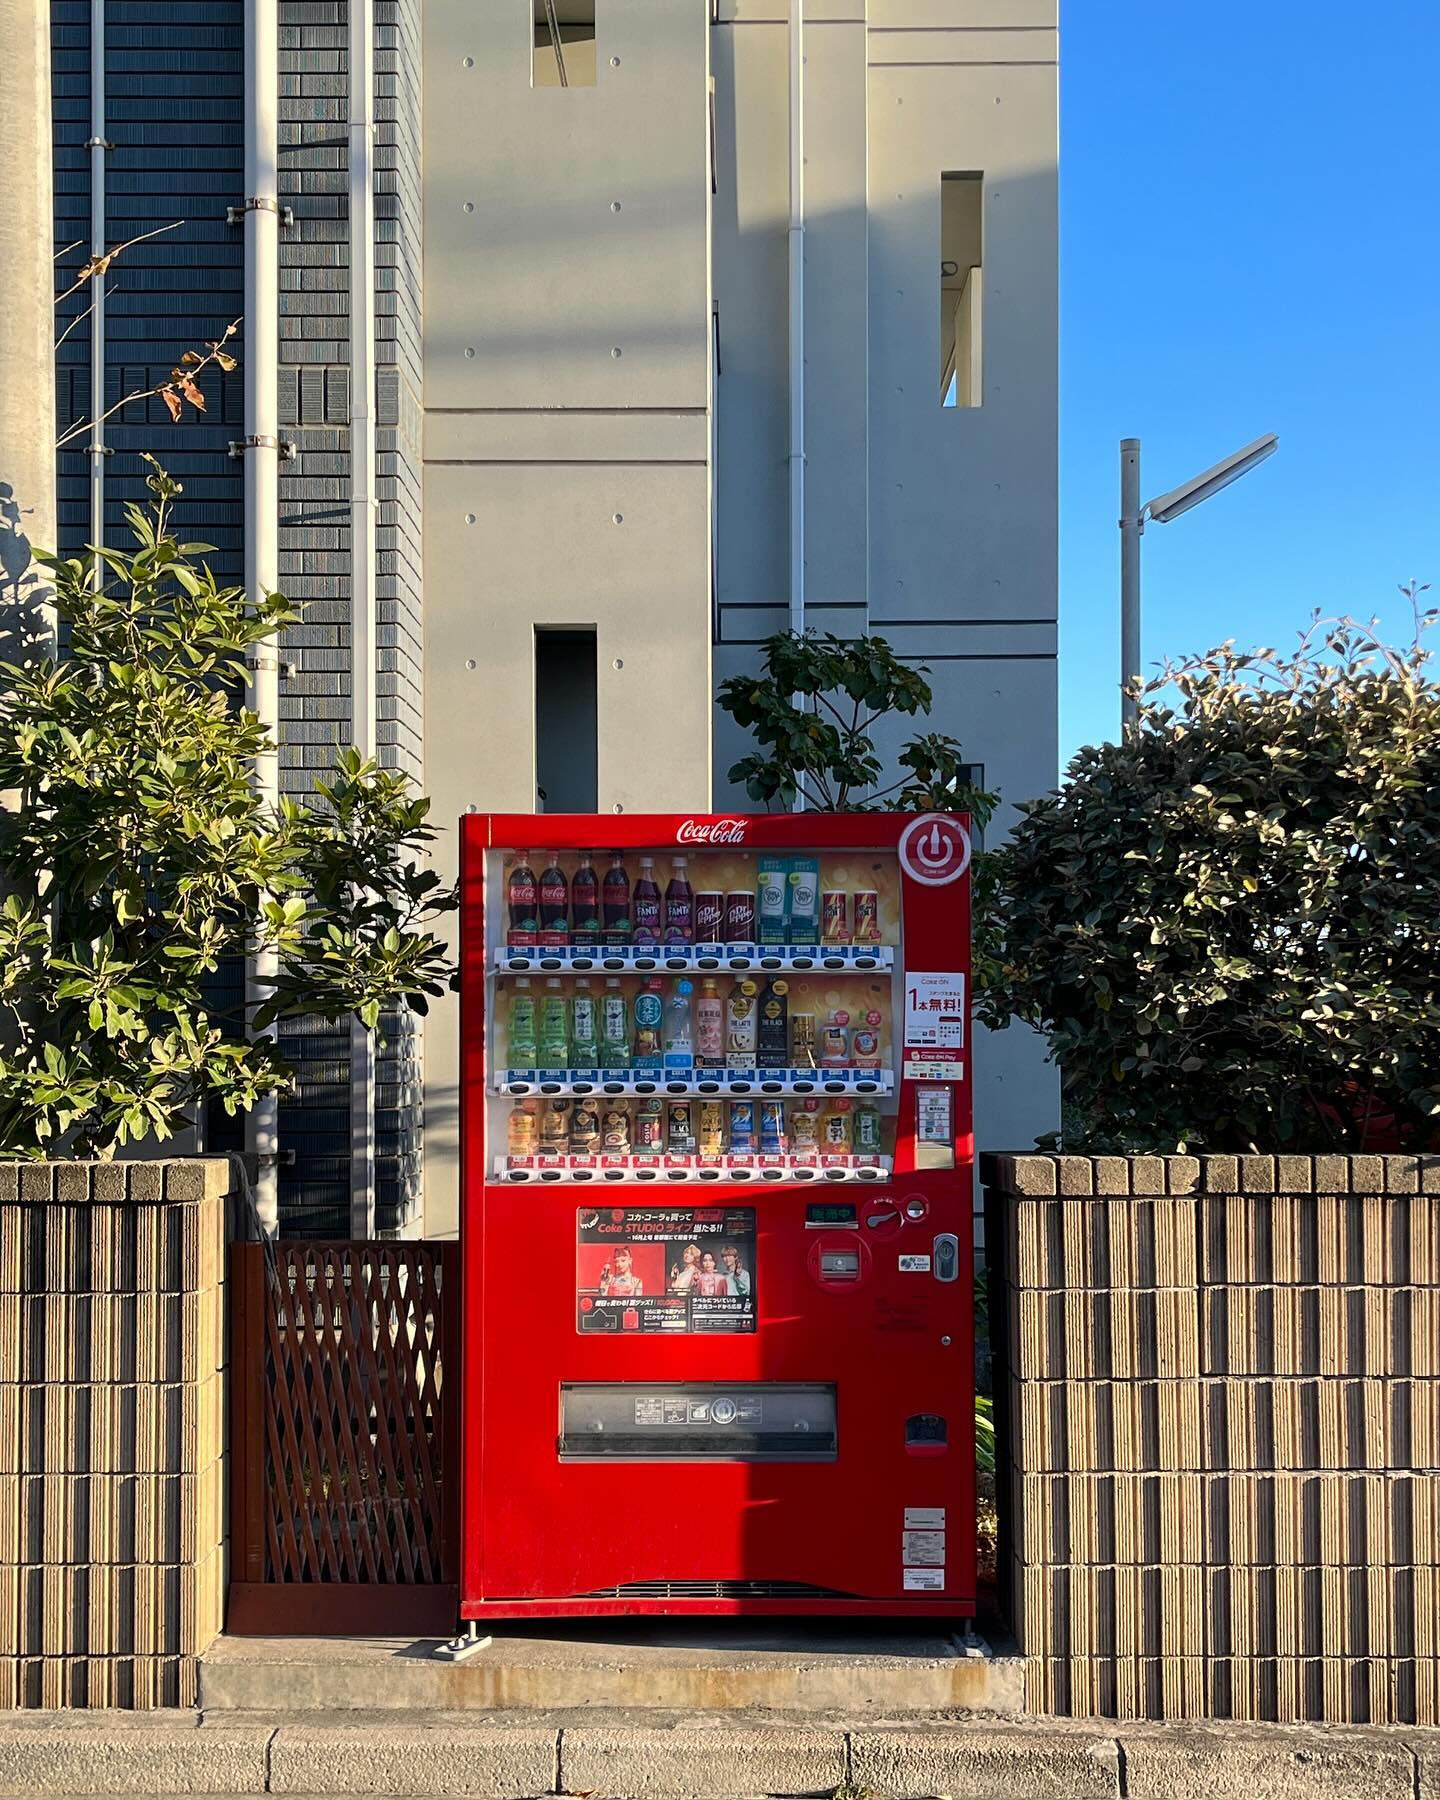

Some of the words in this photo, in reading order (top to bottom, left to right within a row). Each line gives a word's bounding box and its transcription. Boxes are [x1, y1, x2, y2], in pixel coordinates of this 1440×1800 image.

[676, 819, 750, 844] Coca-Cola
[704, 906, 715, 916] Dr
[735, 905, 747, 915] Dr
[908, 988, 961, 1012] 1本無料!
[598, 1224, 623, 1233] Coke
[625, 1223, 664, 1233] STUDIO
